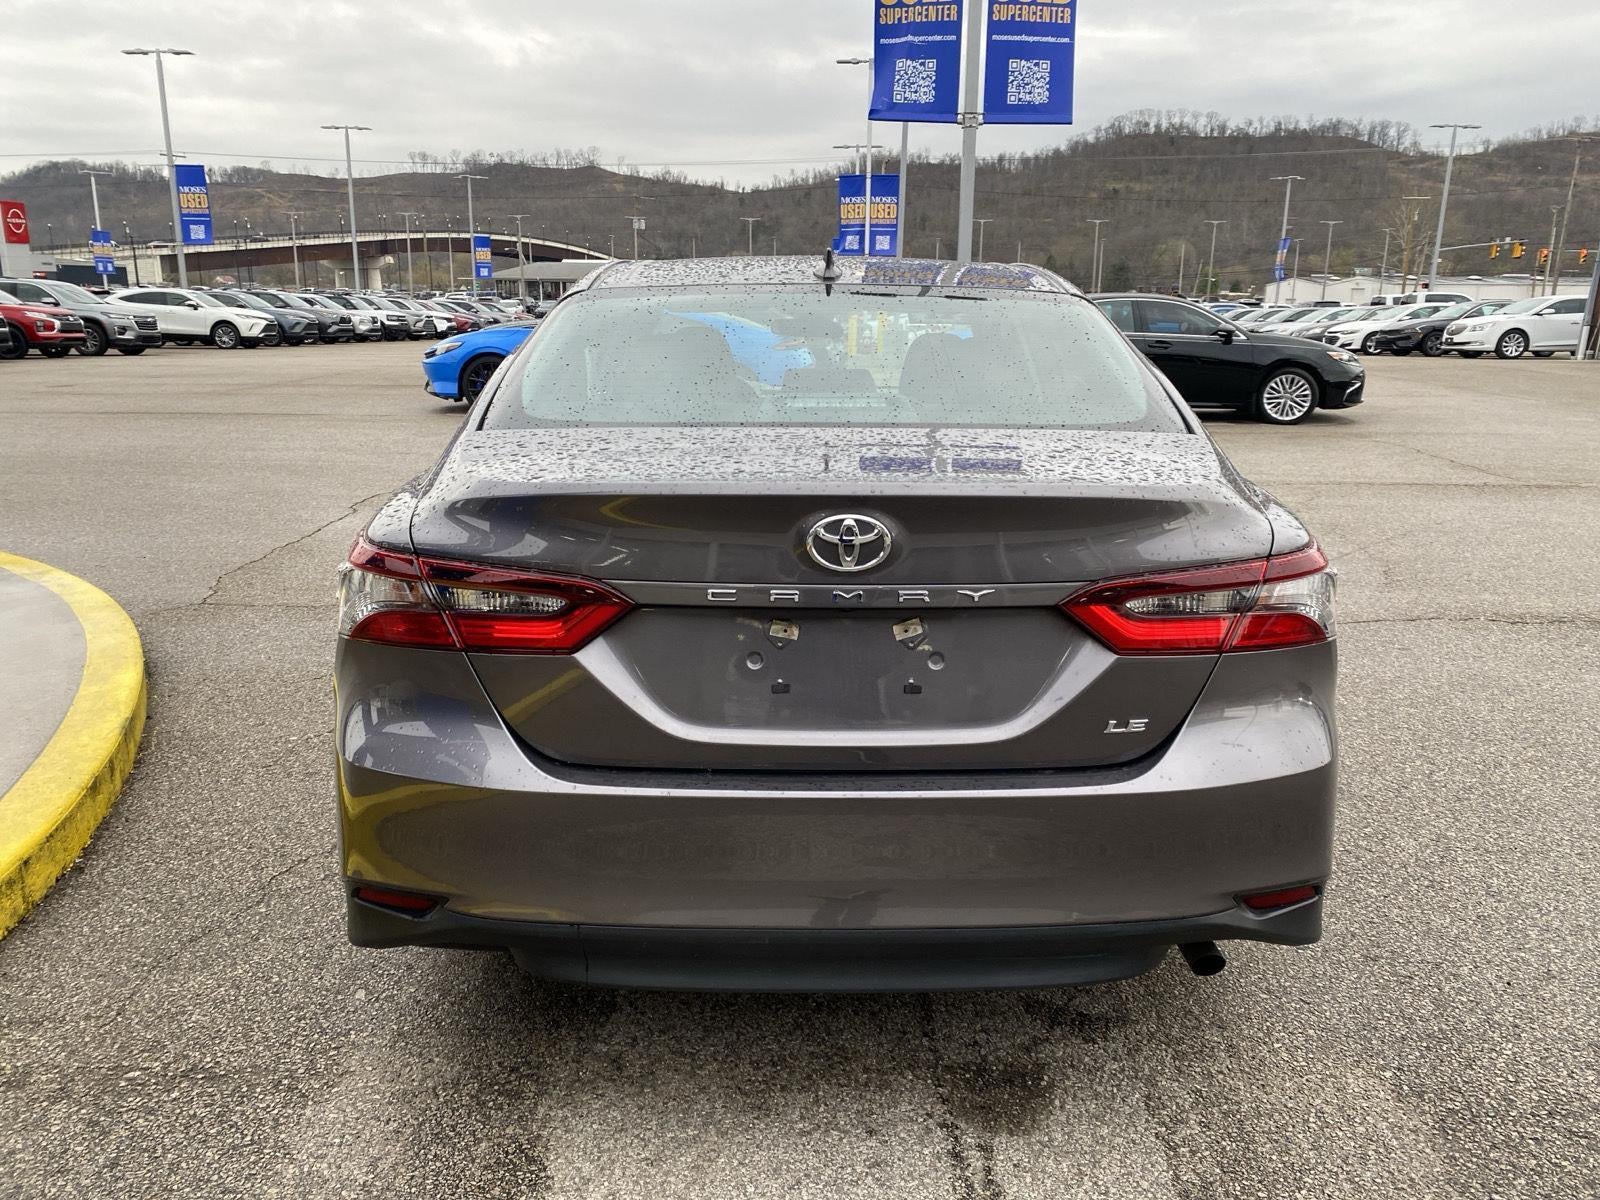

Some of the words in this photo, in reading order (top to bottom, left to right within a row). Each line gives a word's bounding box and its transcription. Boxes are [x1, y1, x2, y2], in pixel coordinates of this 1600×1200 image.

[879, 4, 958, 25] SUPERCENTER
[992, 4, 1072, 24] SUPERCENTER
[991, 33, 1070, 43] mosesusedsupercenter.com
[179, 193, 208, 208] USED
[870, 204, 897, 218] USED
[707, 588, 996, 603] CAMRY
[1103, 718, 1149, 734] LE
